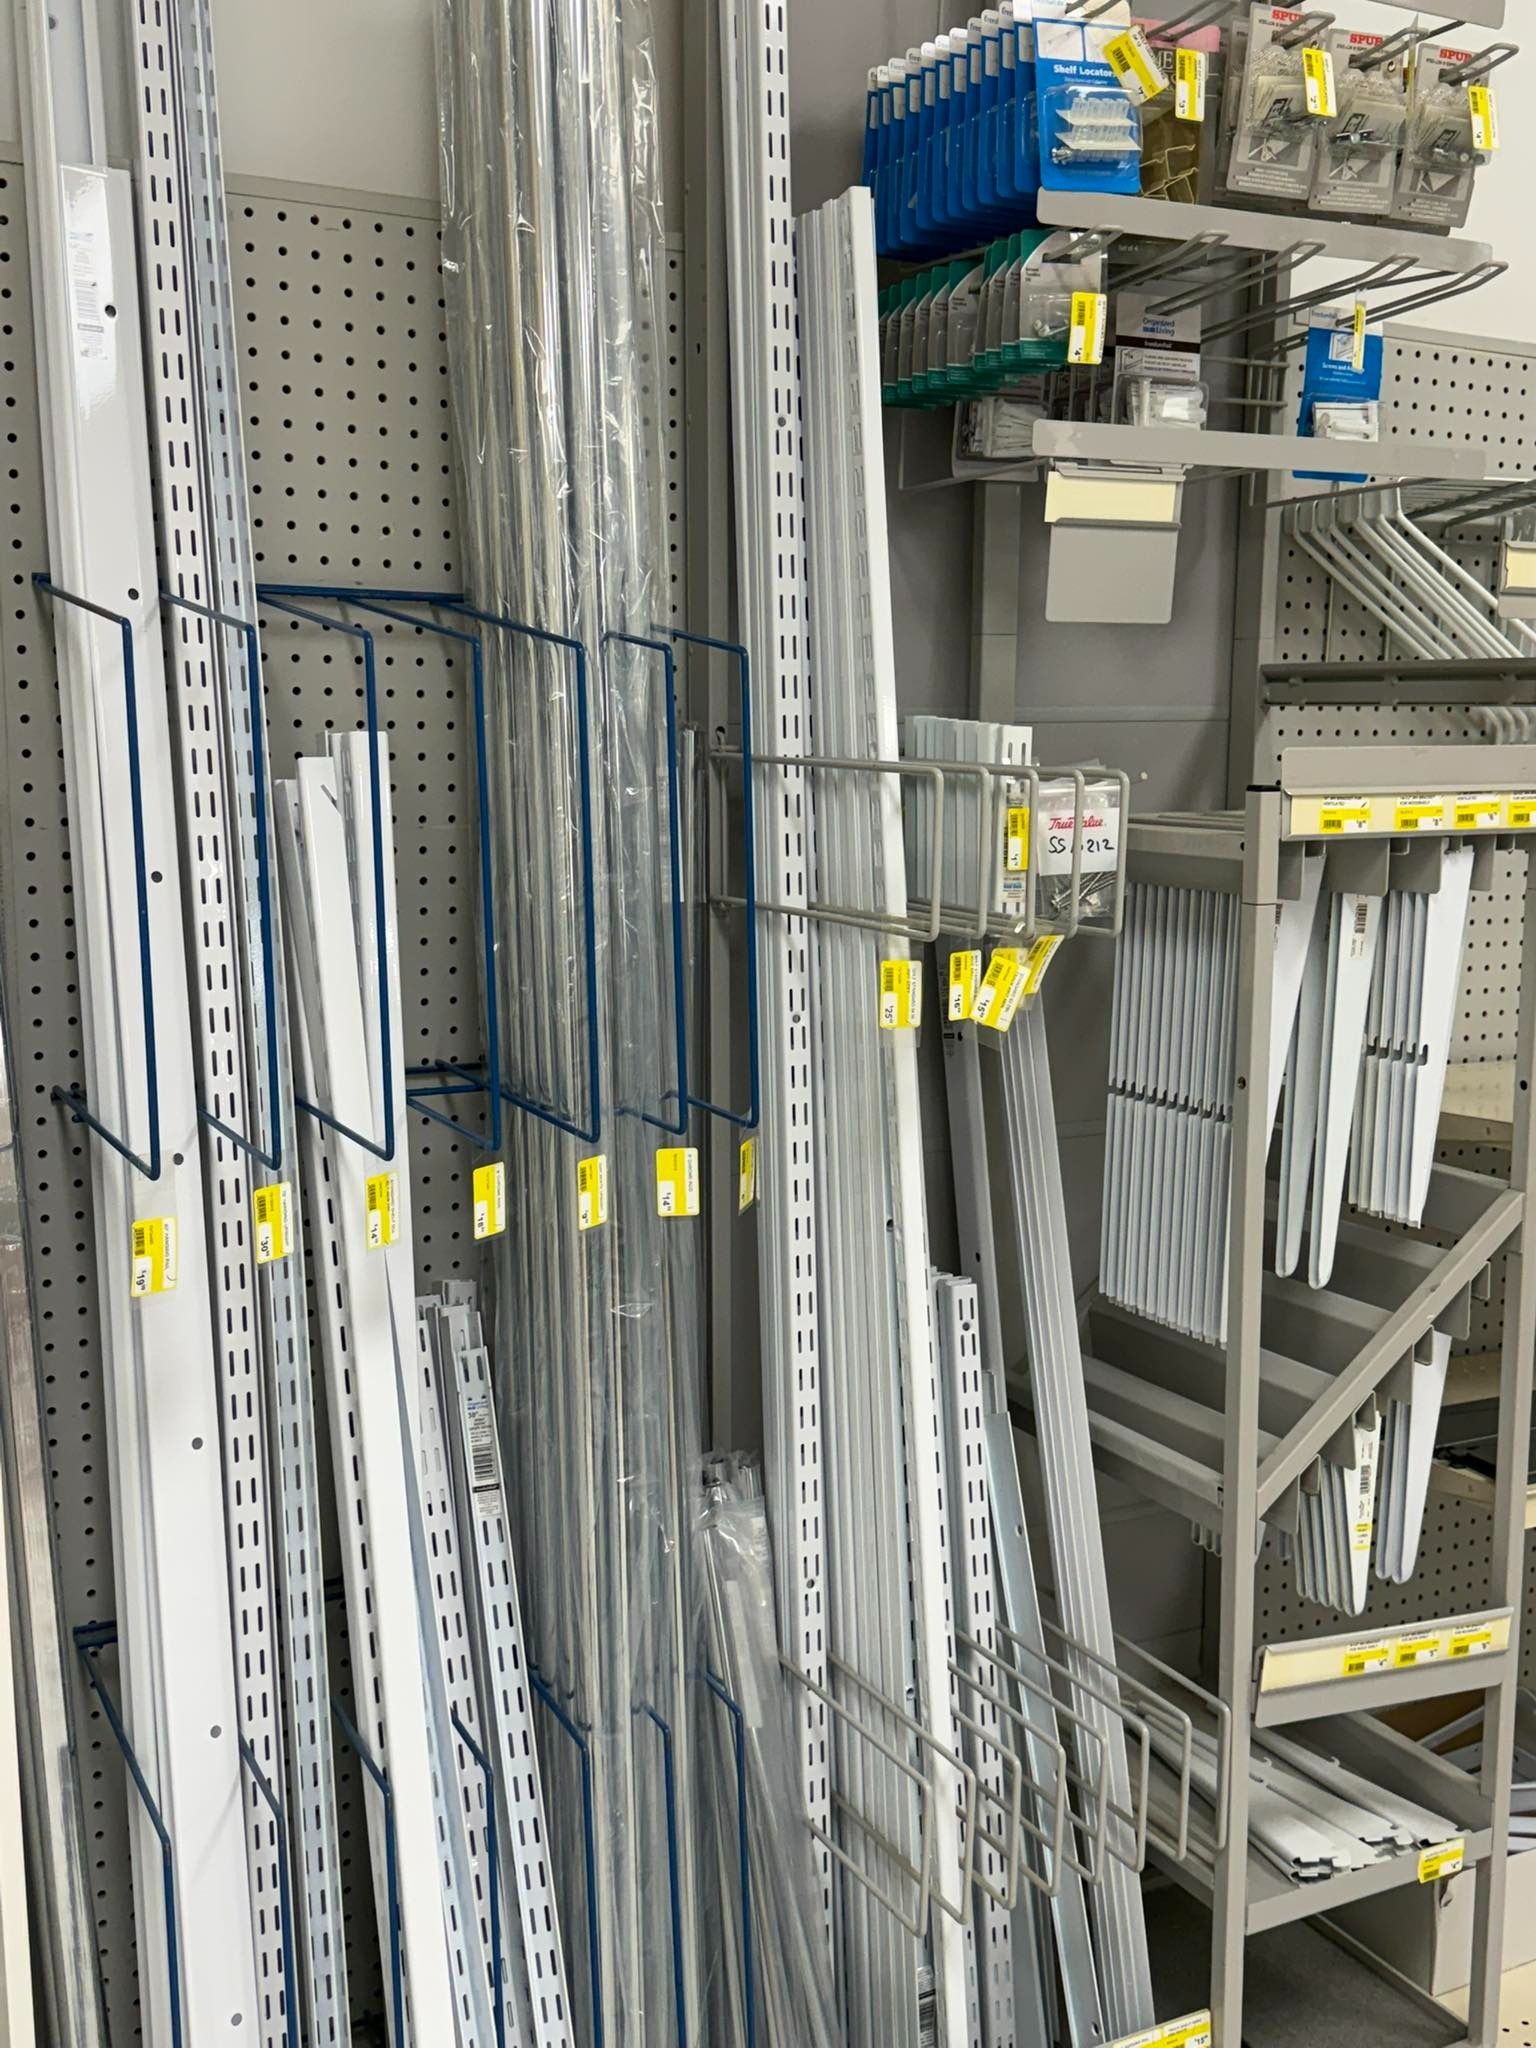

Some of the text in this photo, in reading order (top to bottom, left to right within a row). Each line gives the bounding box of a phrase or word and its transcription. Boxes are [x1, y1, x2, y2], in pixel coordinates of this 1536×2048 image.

[1053, 64, 1115, 77] Shelf Locator
[1048, 816, 1074, 830] True
[1086, 838, 1115, 853] 212
